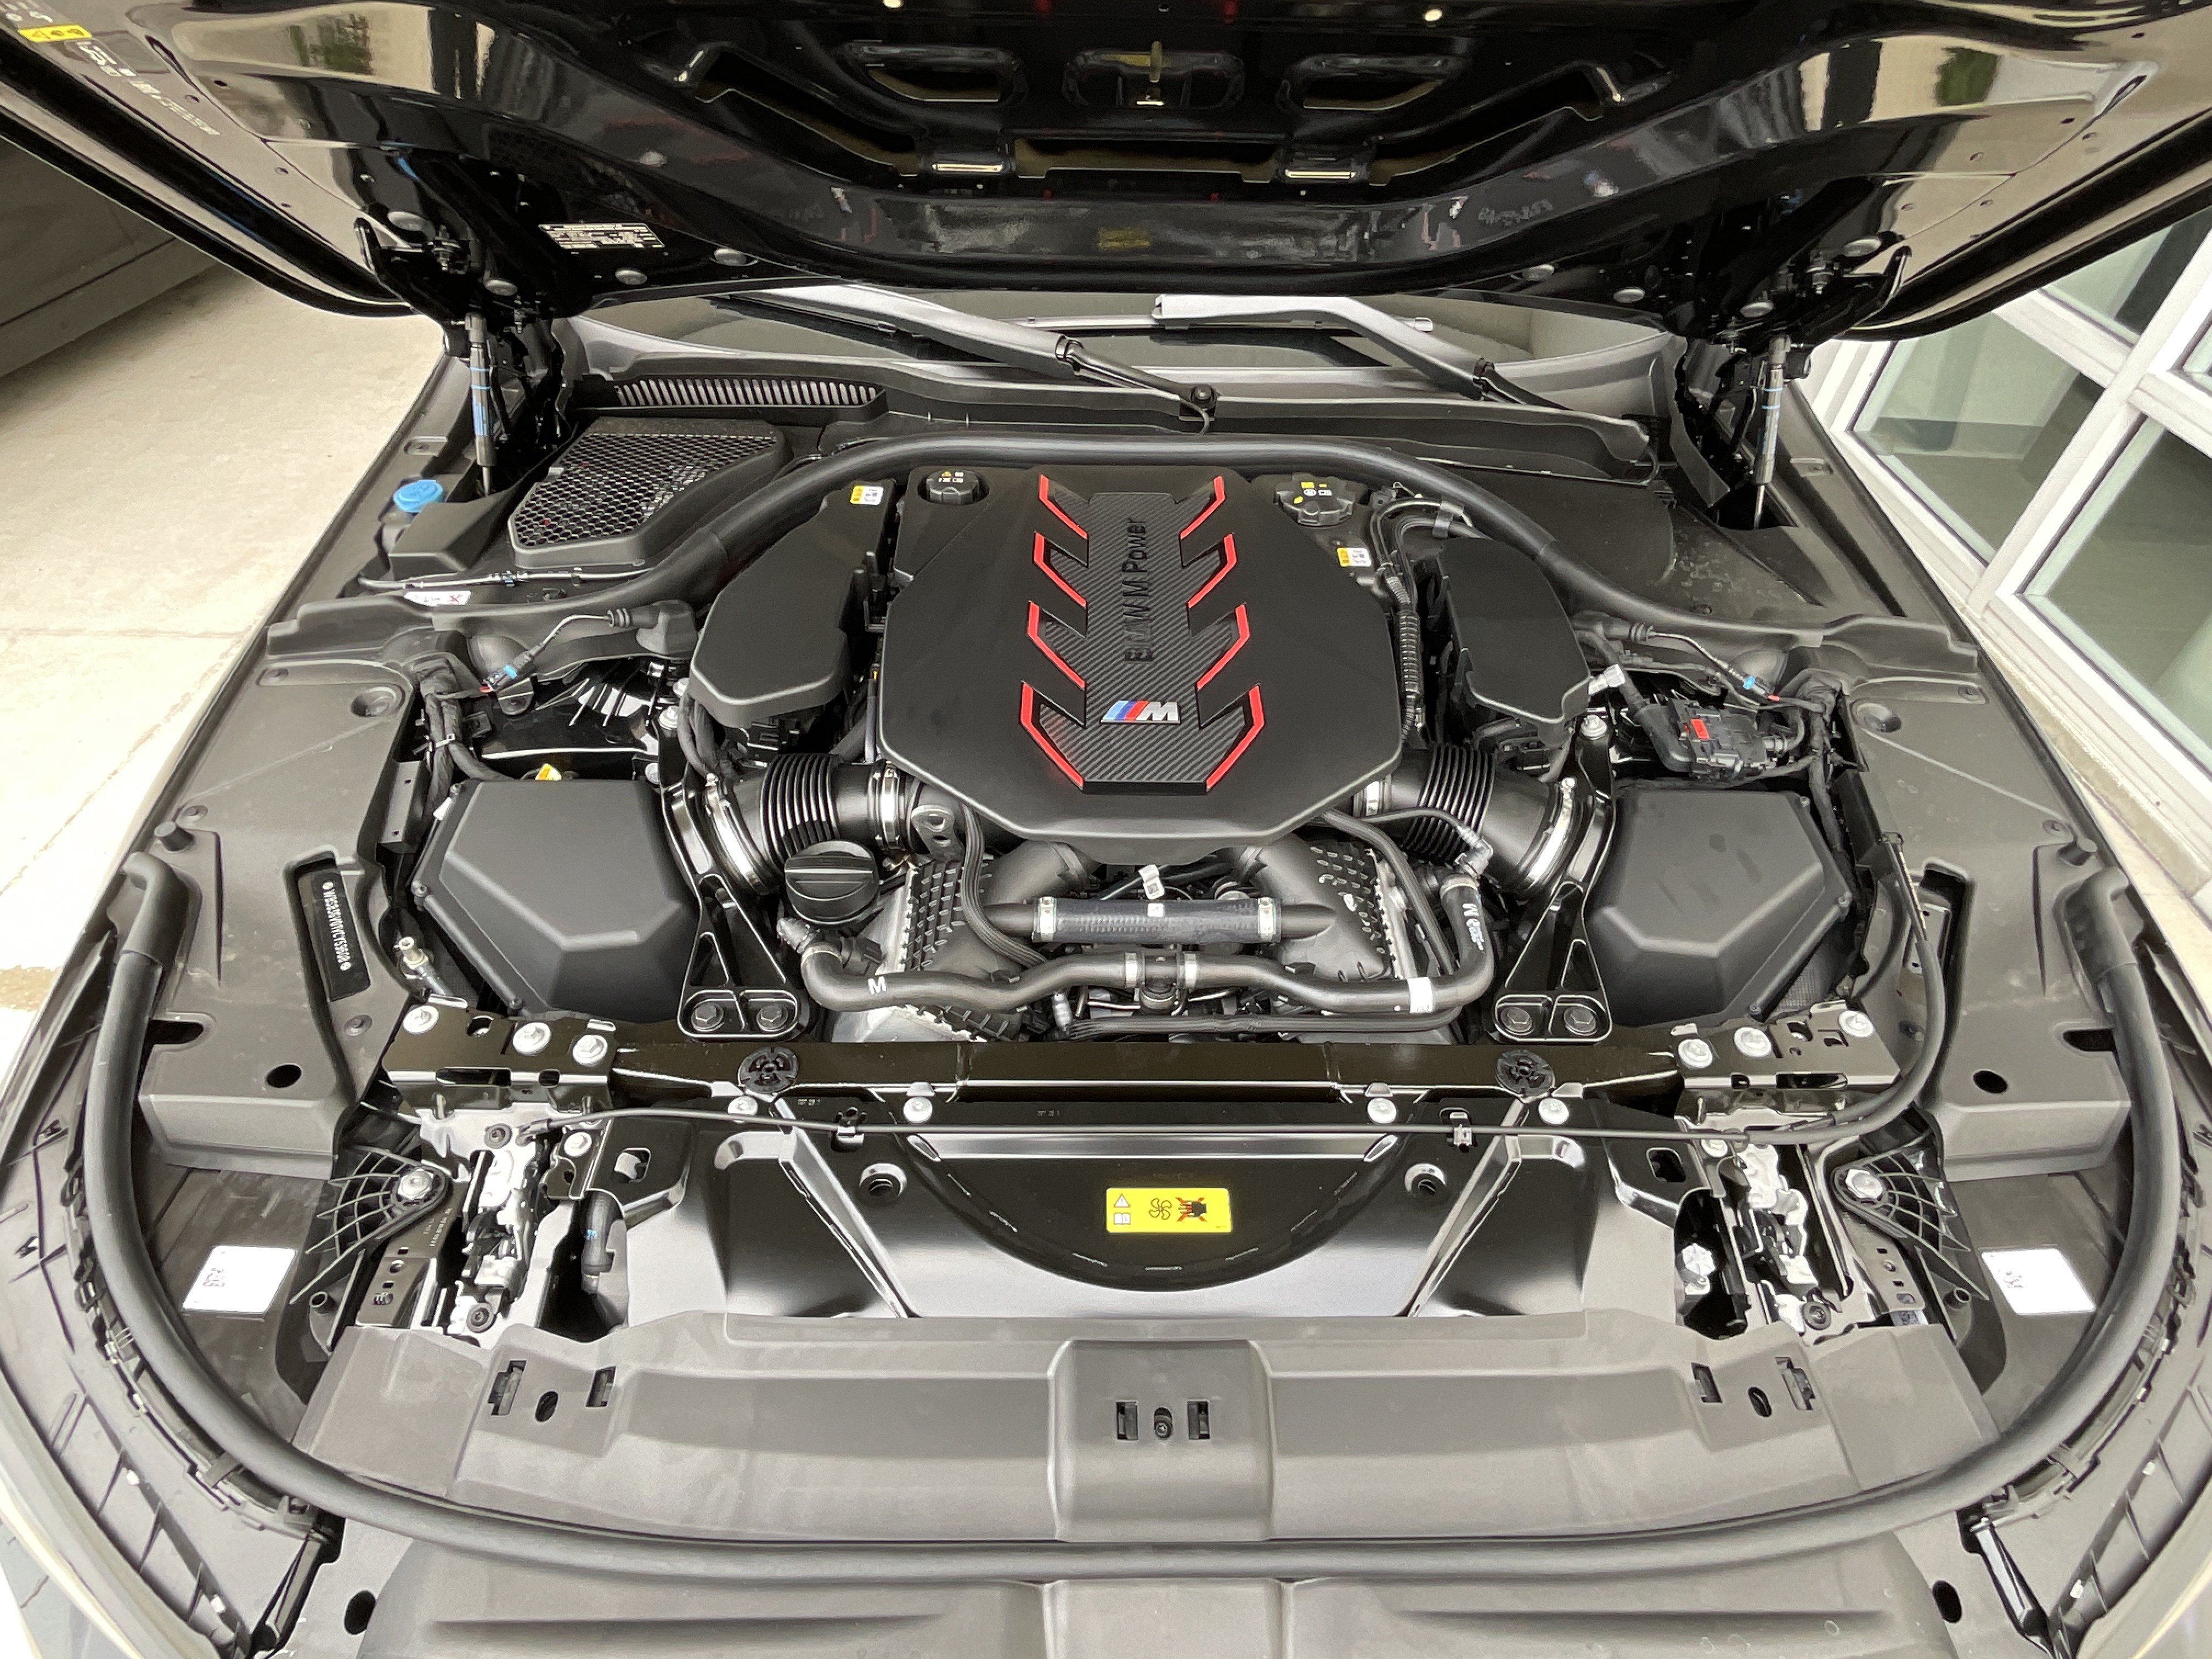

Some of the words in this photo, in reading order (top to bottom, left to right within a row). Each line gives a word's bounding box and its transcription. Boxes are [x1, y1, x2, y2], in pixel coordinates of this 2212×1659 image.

[1122, 517, 1148, 572] Power
[1133, 700, 1180, 723] M
[867, 975, 887, 995] M
